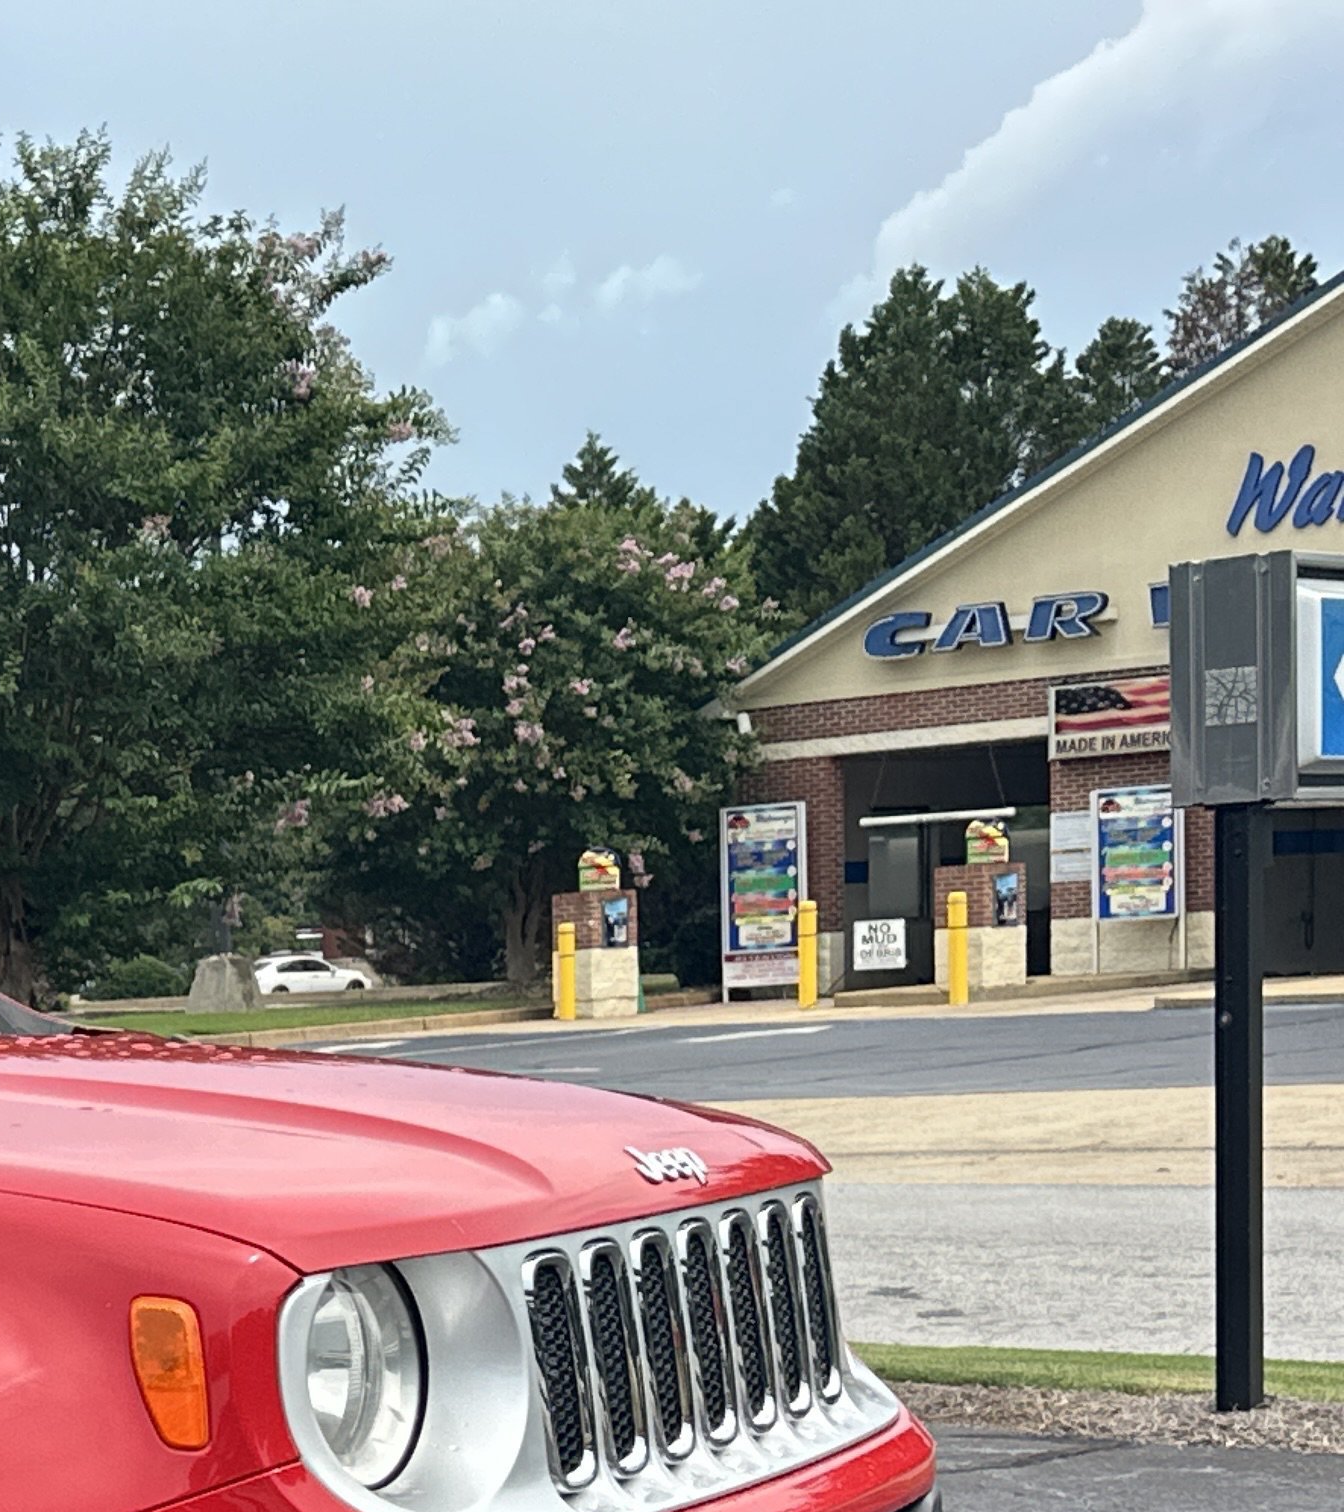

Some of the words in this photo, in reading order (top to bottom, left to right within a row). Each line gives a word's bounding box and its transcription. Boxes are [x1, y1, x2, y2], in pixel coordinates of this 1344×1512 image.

[863, 590, 1110, 662] CAR
[1055, 737, 1097, 753] MADE
[1101, 735, 1116, 751] IN
[868, 922, 891, 934] NO
[861, 933, 897, 945] MUD
[622, 1144, 709, 1188] Jeep
